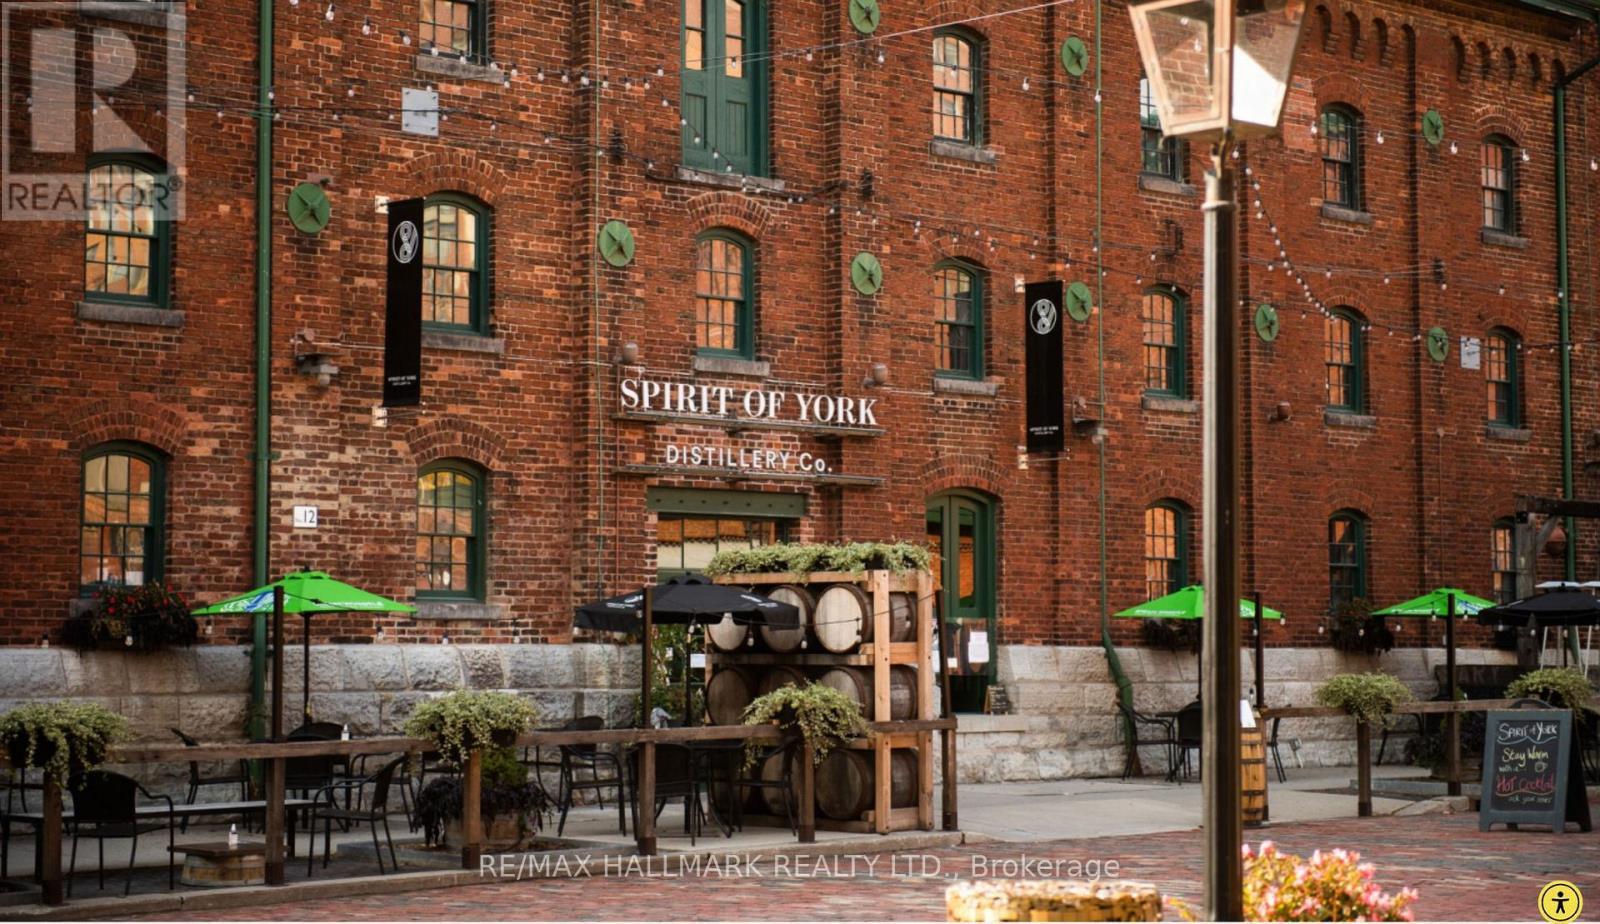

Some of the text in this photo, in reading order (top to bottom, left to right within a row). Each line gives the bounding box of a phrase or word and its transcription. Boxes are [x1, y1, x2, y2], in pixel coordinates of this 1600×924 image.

[620, 378, 879, 426] SPIRIT OF YORK
[665, 444, 791, 470] DISTILLERY
[303, 508, 316, 524] 12
